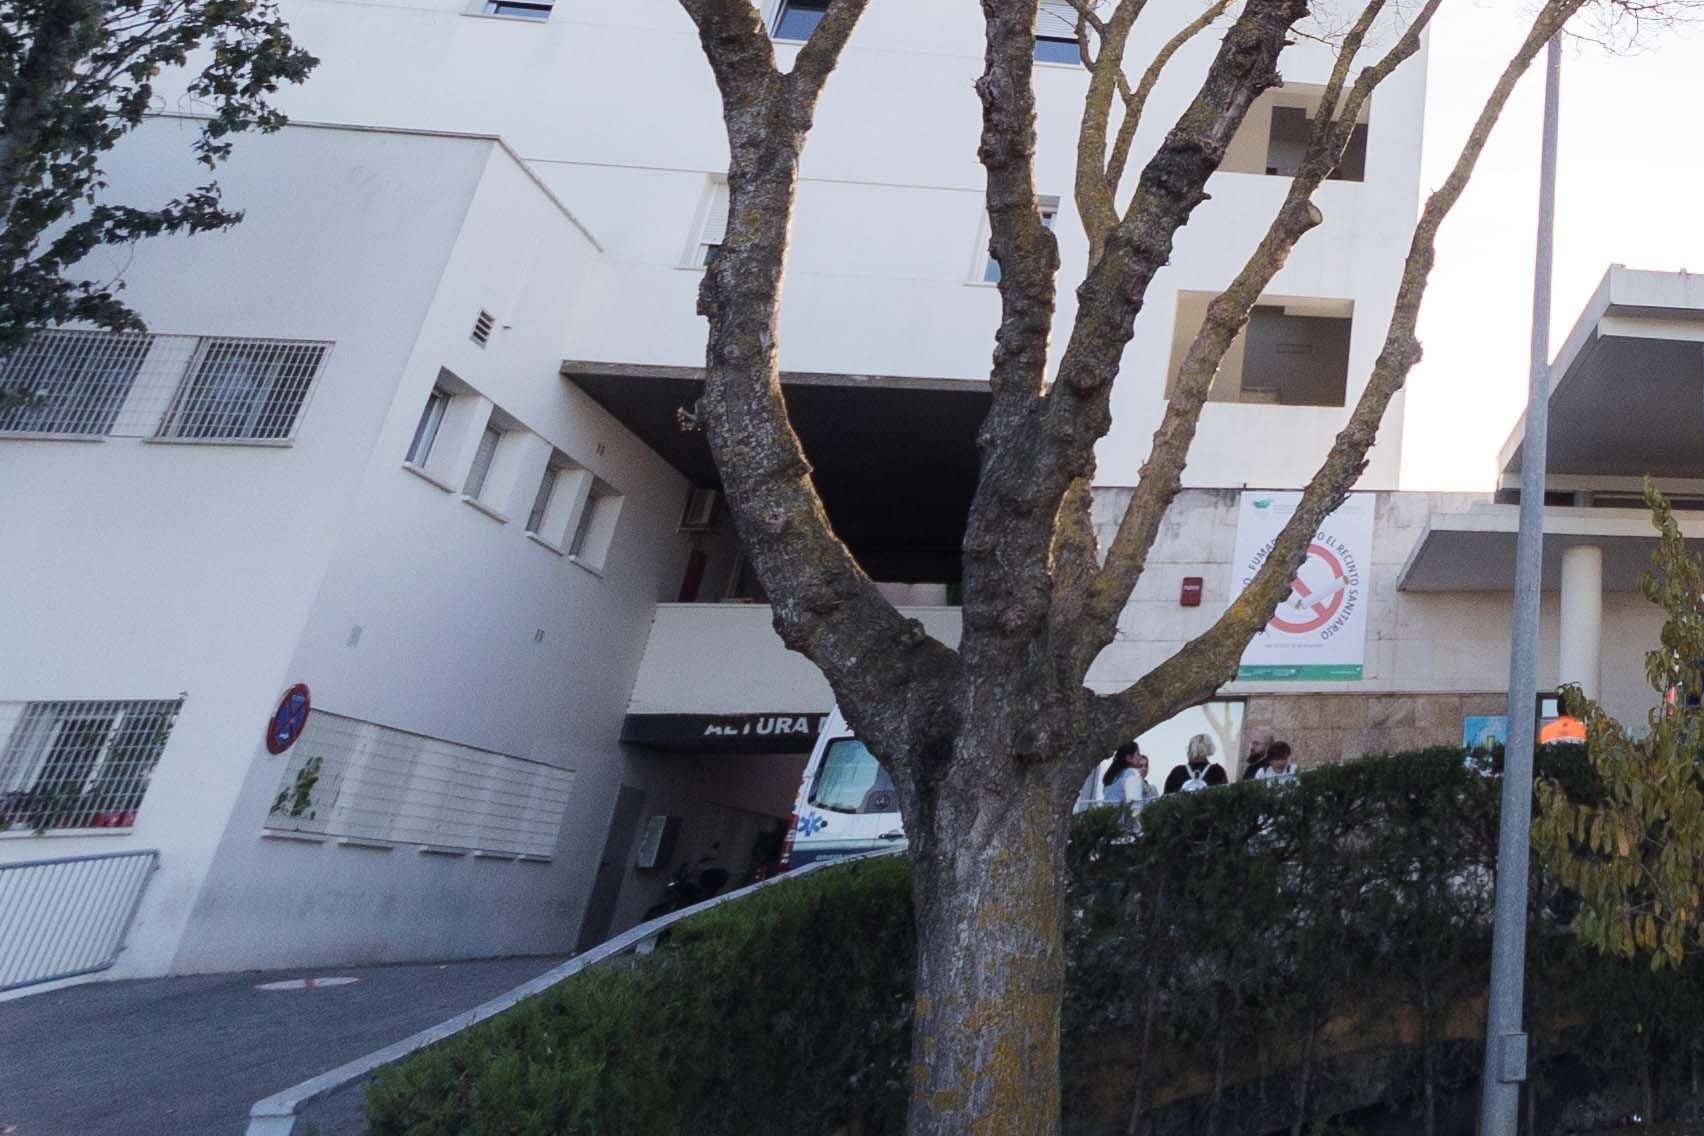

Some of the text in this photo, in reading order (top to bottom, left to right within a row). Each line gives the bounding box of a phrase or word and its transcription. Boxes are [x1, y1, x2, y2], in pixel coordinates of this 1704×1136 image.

[1325, 535, 1337, 546] EL
[1336, 544, 1359, 586] RECINTO
[1320, 589, 1359, 640] SANITARIO
